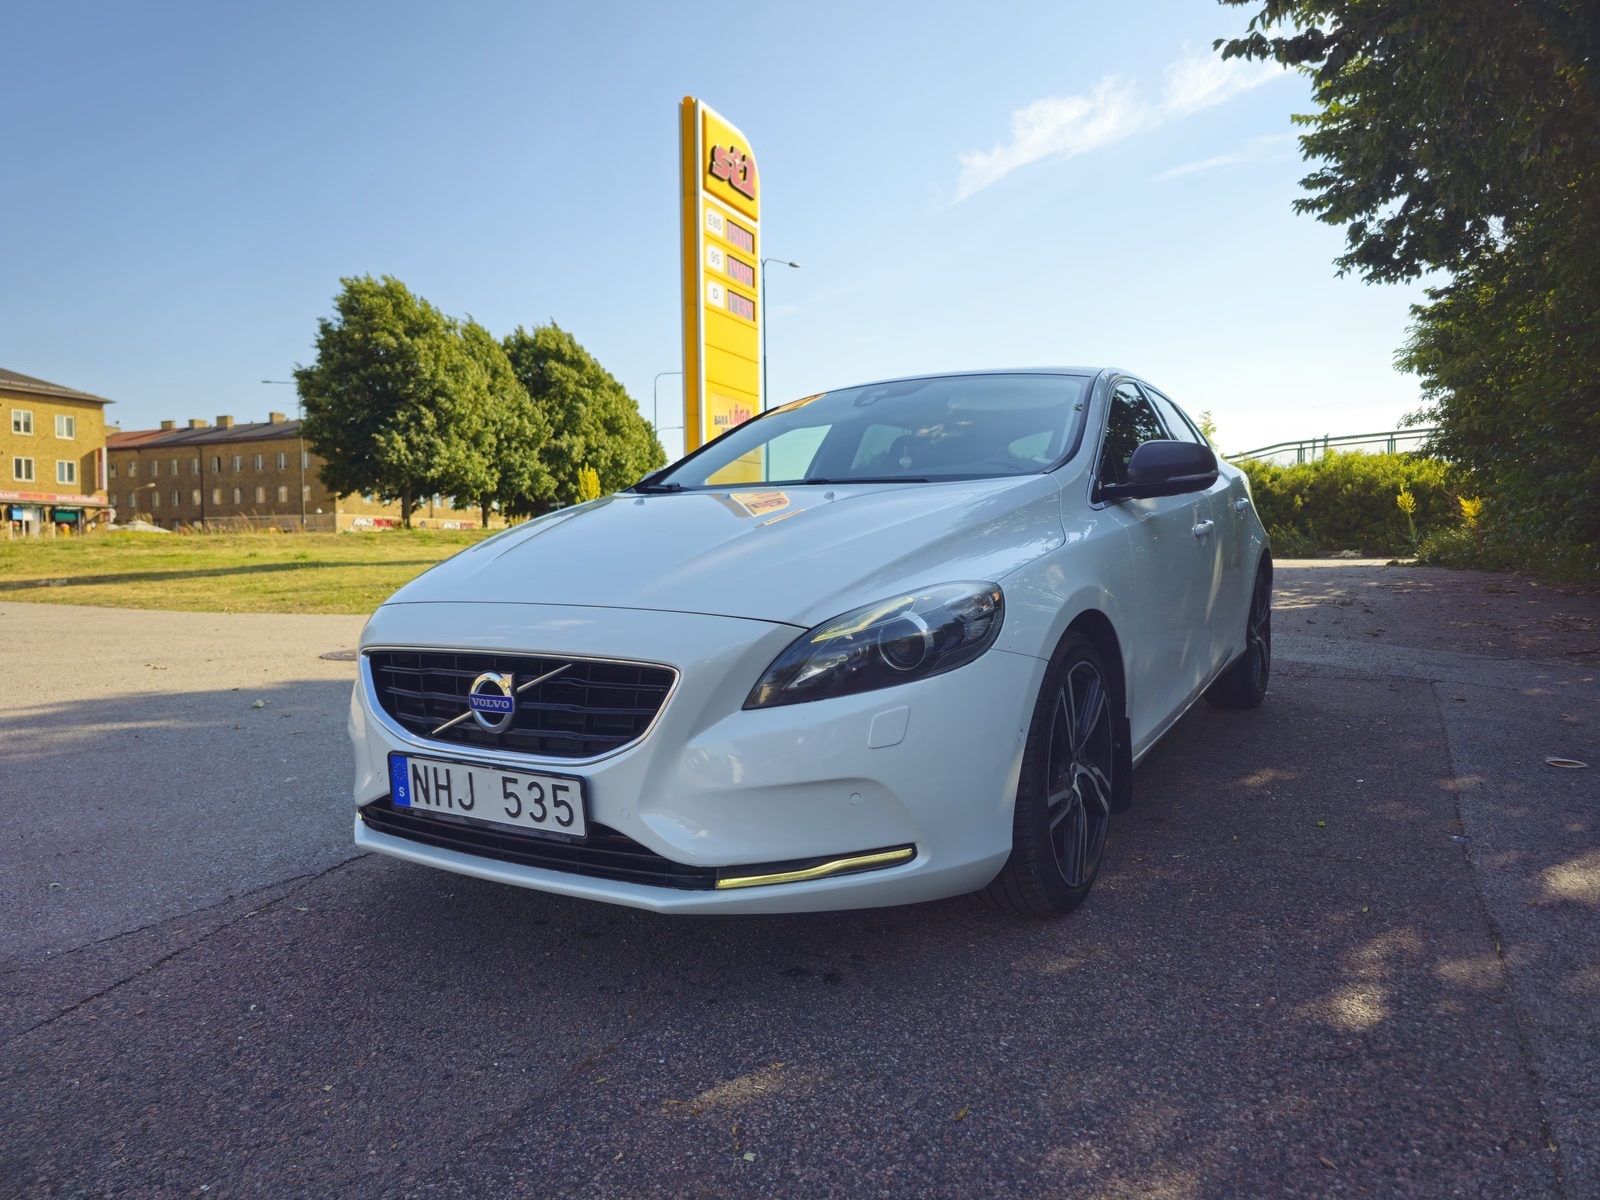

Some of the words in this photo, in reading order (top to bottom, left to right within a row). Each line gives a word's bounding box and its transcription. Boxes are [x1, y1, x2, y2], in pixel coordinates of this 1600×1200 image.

[708, 214, 722, 231] E85
[711, 251, 720, 265] 95
[713, 288, 719, 300] D
[714, 415, 728, 426] BARA
[470, 697, 510, 709] VOLVO
[398, 786, 405, 798] S
[411, 763, 475, 811] NHJ
[501, 776, 574, 827] 535
